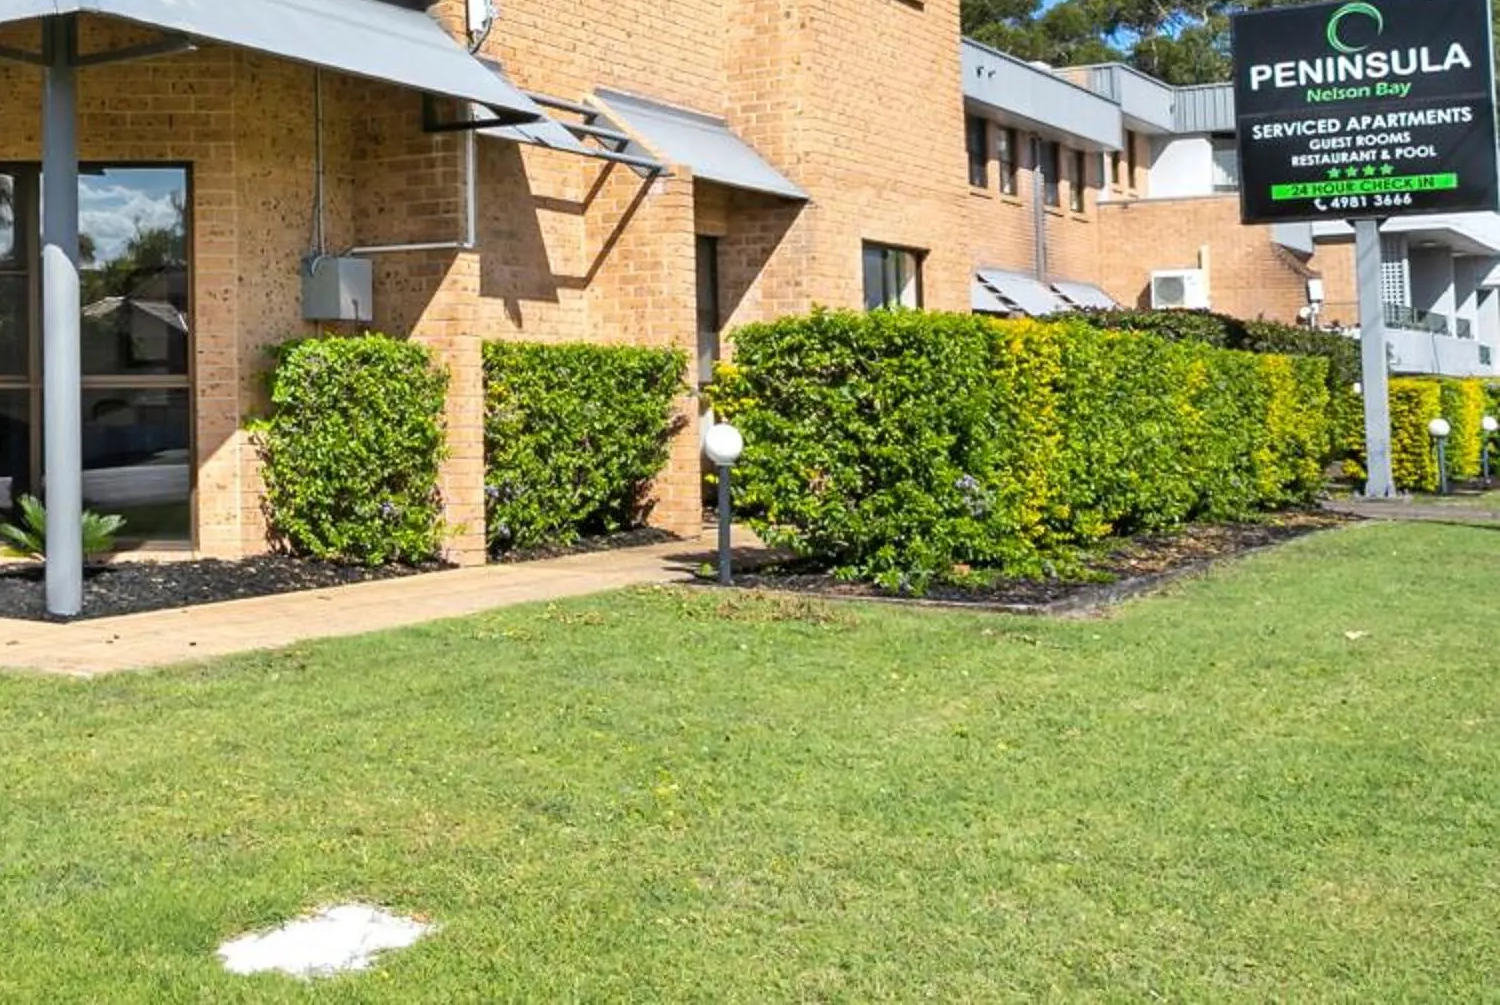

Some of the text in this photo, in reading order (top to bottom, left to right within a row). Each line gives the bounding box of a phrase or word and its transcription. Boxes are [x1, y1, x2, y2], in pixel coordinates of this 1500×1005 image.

[1250, 42, 1472, 91] PENINSULA
[1306, 82, 1412, 102] Nelson Bay
[1252, 106, 1473, 140] SERVICED APARTMENTS
[1309, 131, 1412, 151] GUEST ROOMS
[1291, 145, 1437, 167] RESTAURANT & POOL
[1290, 176, 1435, 196] 24 HOUR CHECK IN
[1330, 193, 1412, 209] 4981 3666
